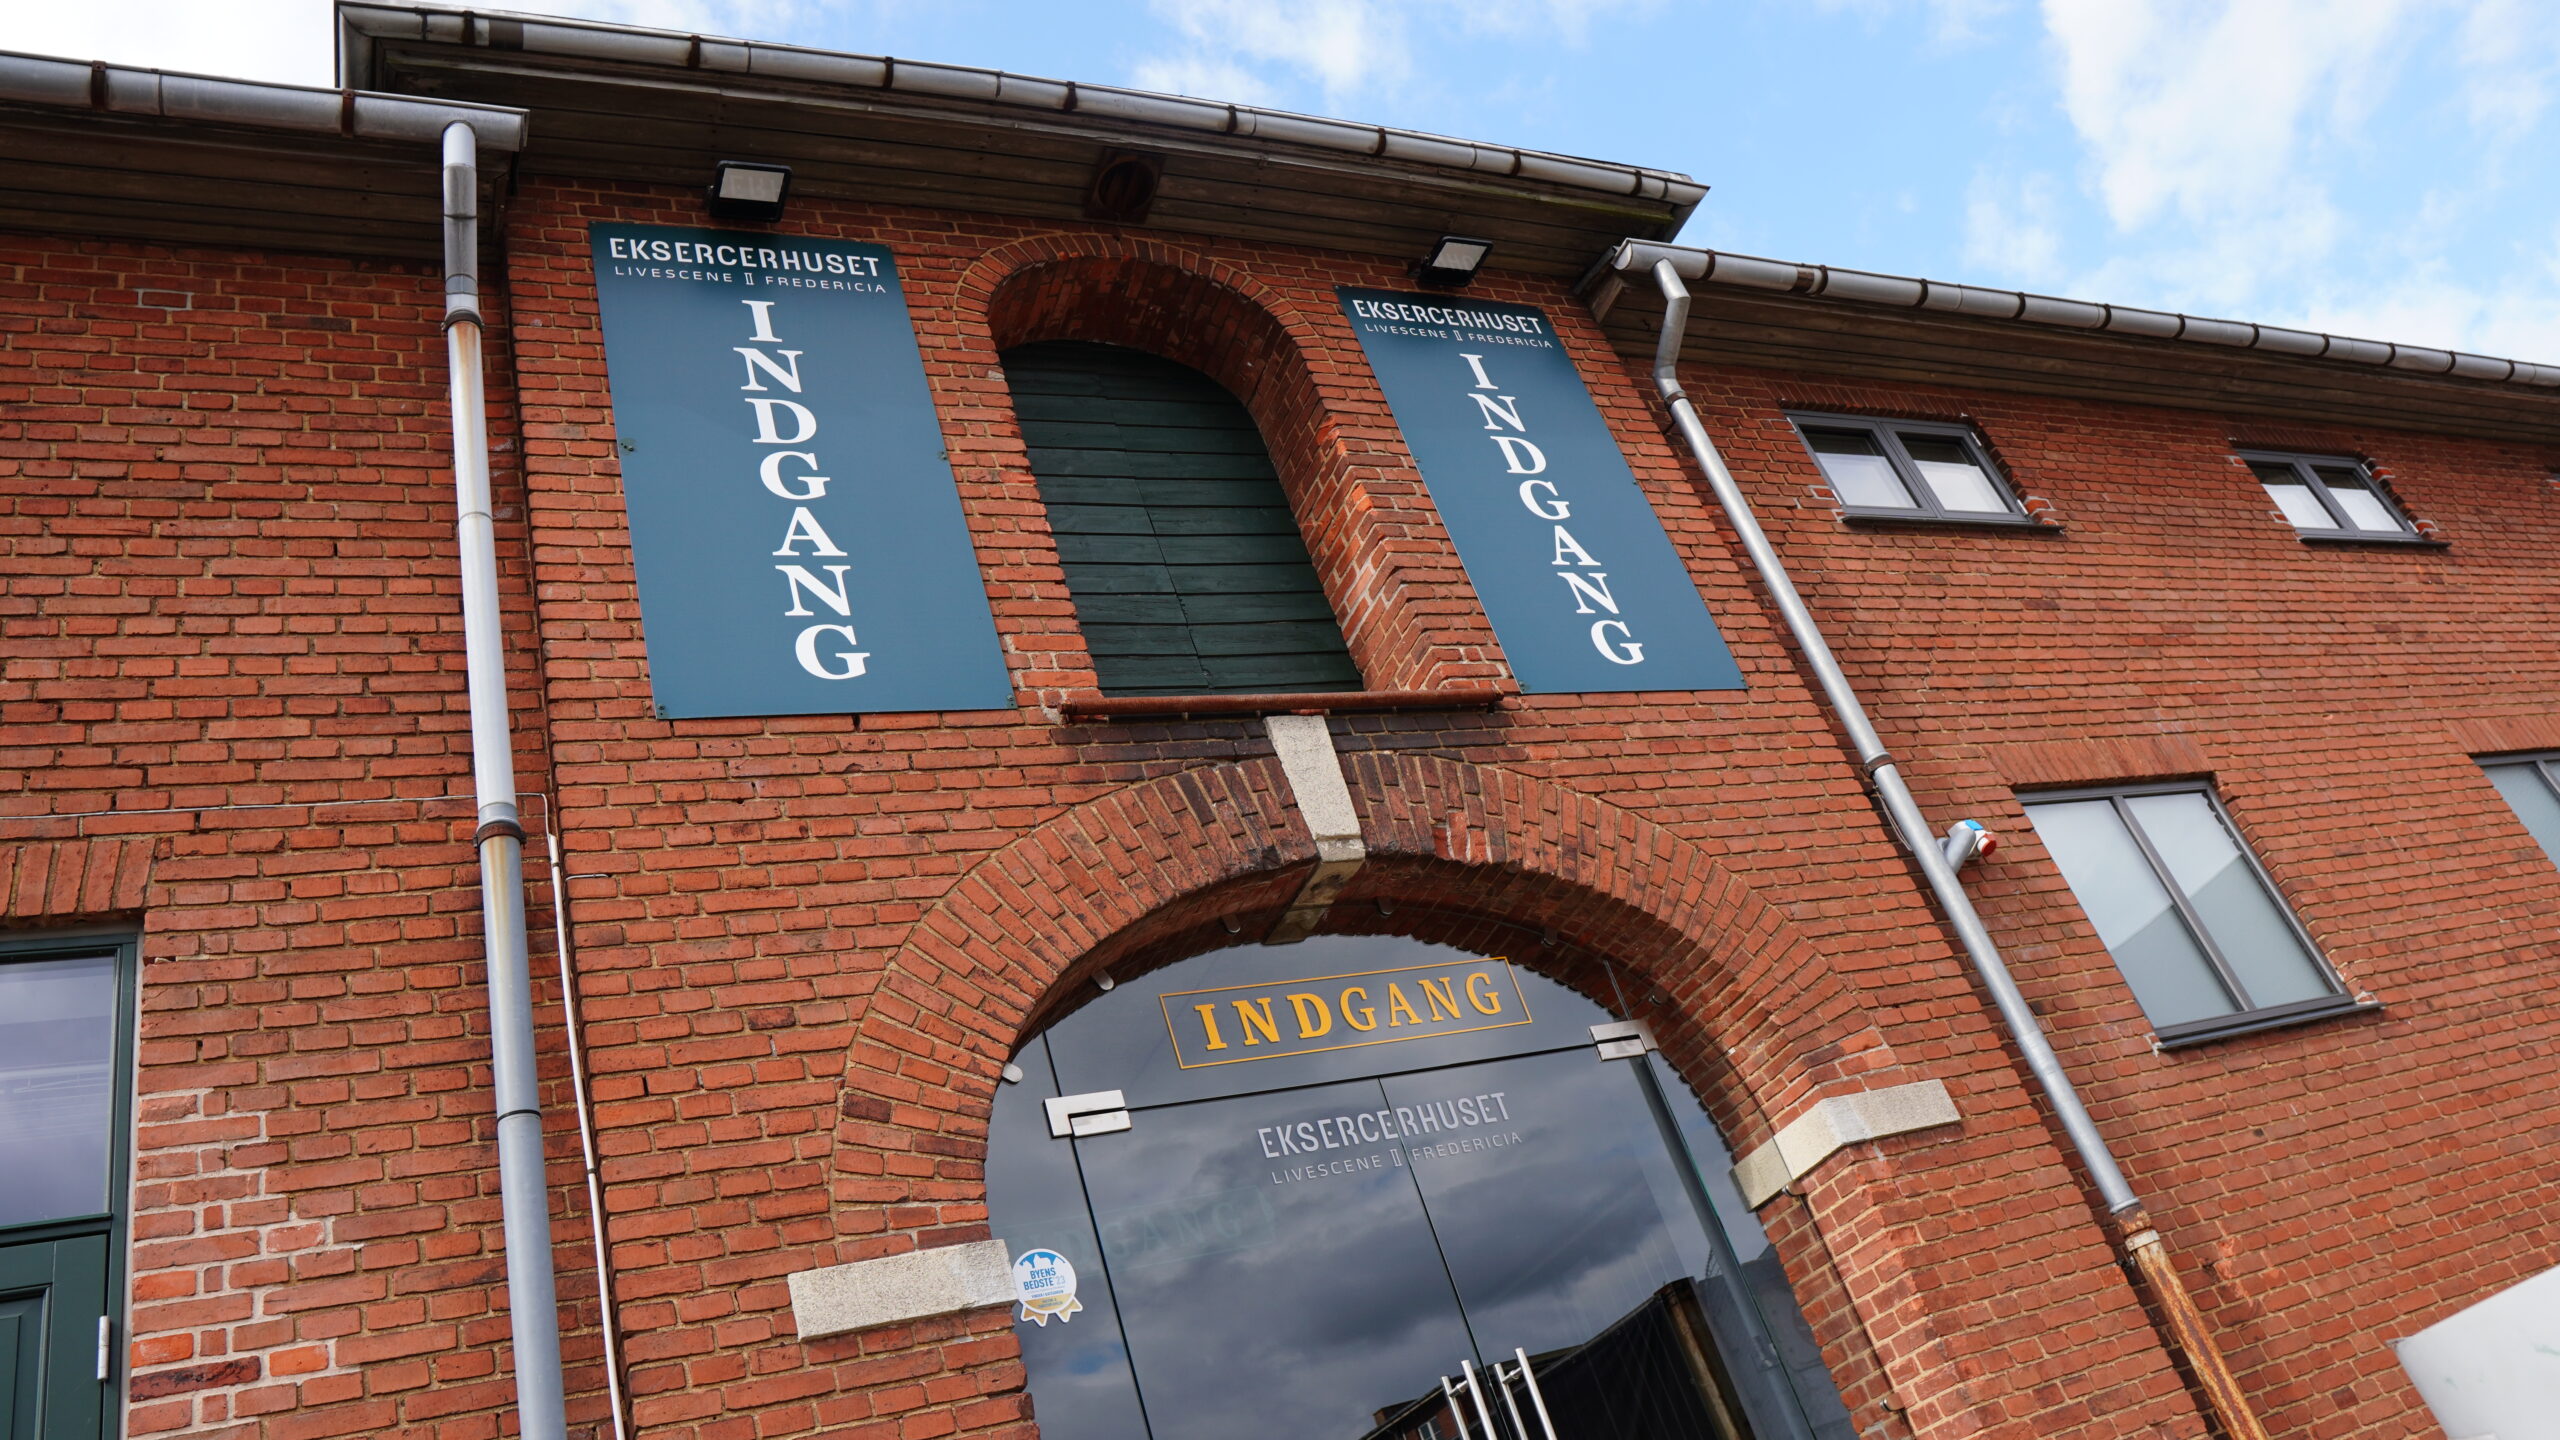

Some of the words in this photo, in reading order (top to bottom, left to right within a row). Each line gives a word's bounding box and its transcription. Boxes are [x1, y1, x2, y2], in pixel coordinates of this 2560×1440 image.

[609, 237, 879, 277] EKSERCERHUSET
[614, 265, 733, 283] LIVESCENE
[765, 275, 887, 294] FREDERICIA
[1352, 299, 1543, 335] EKSERCERHUSET
[1365, 323, 1448, 339] LIVESCENE
[1468, 333, 1553, 349] FREDERICIA
[733, 299, 871, 681] INDGANG
[1459, 353, 1645, 665] INDGANG
[1195, 971, 1503, 1052] INDGANG
[1257, 1092, 1511, 1159] EKSERCERHUSET
[1271, 1154, 1383, 1185] LIVESCENE
[1412, 1131, 1522, 1161] FREDERICIA
[1023, 1277, 1055, 1291] BEDSTE
[1030, 1267, 1057, 1280] BYENS
